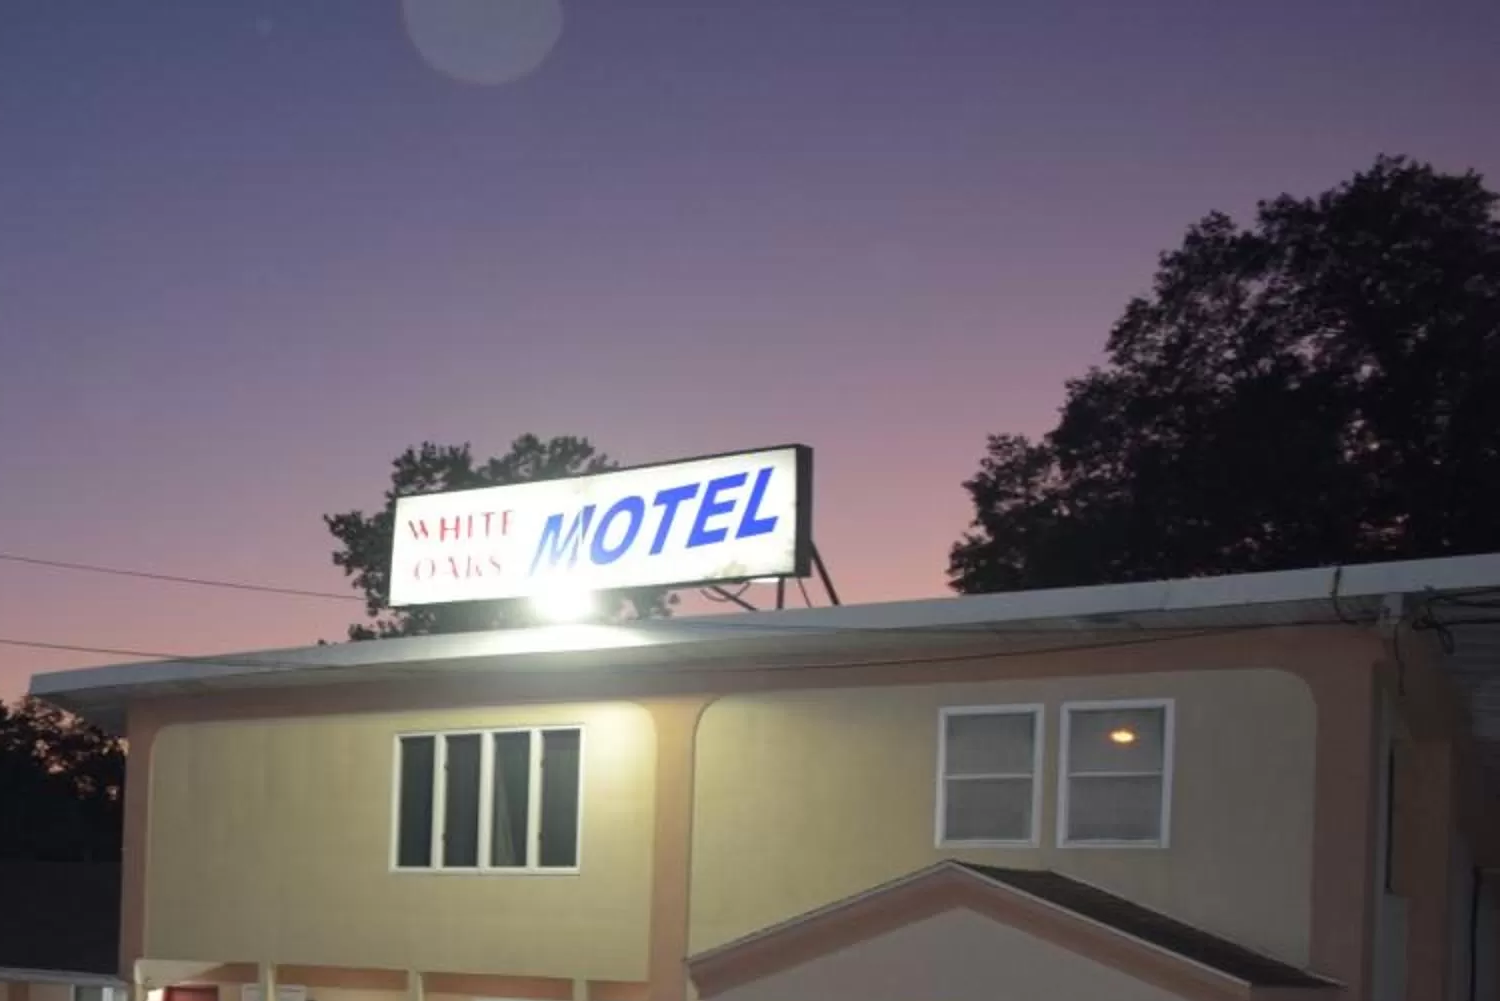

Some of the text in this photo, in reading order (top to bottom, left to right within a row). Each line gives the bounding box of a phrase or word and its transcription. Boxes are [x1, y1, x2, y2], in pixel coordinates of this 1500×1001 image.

[408, 509, 514, 543] WHITE
[529, 468, 780, 577] MOTEL
[413, 554, 501, 581] OAKS
